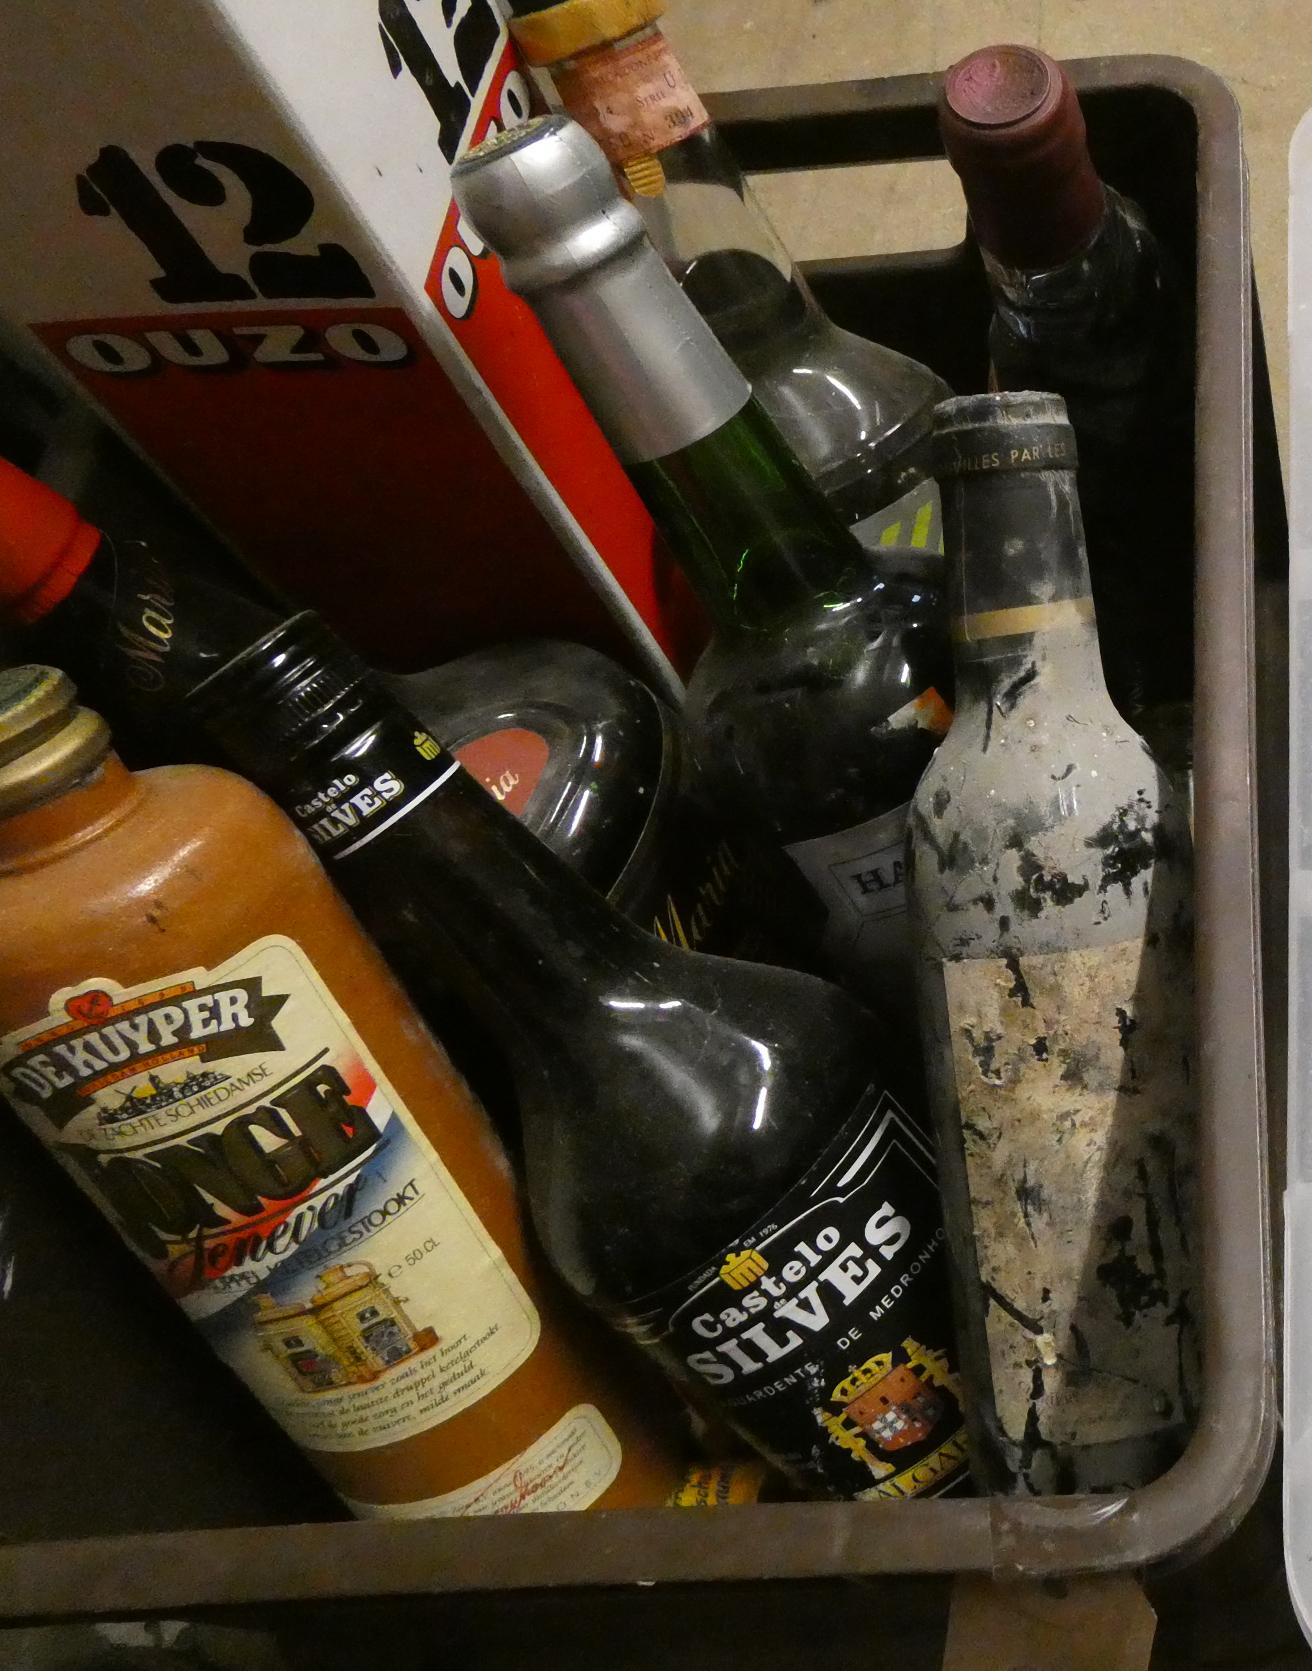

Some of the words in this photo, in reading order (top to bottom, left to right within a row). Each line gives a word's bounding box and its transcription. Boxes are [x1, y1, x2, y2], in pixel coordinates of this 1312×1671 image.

[76, 140, 376, 304] 12
[66, 322, 408, 374] OUZO
[10, 1052, 73, 1099] DE
[54, 987, 255, 1078] KUYPER
[685, 1200, 912, 1388] SILVES
[691, 1223, 842, 1341] Castelo
[836, 1325, 863, 1352] DE
[869, 1226, 948, 1322] MEDRONHO
